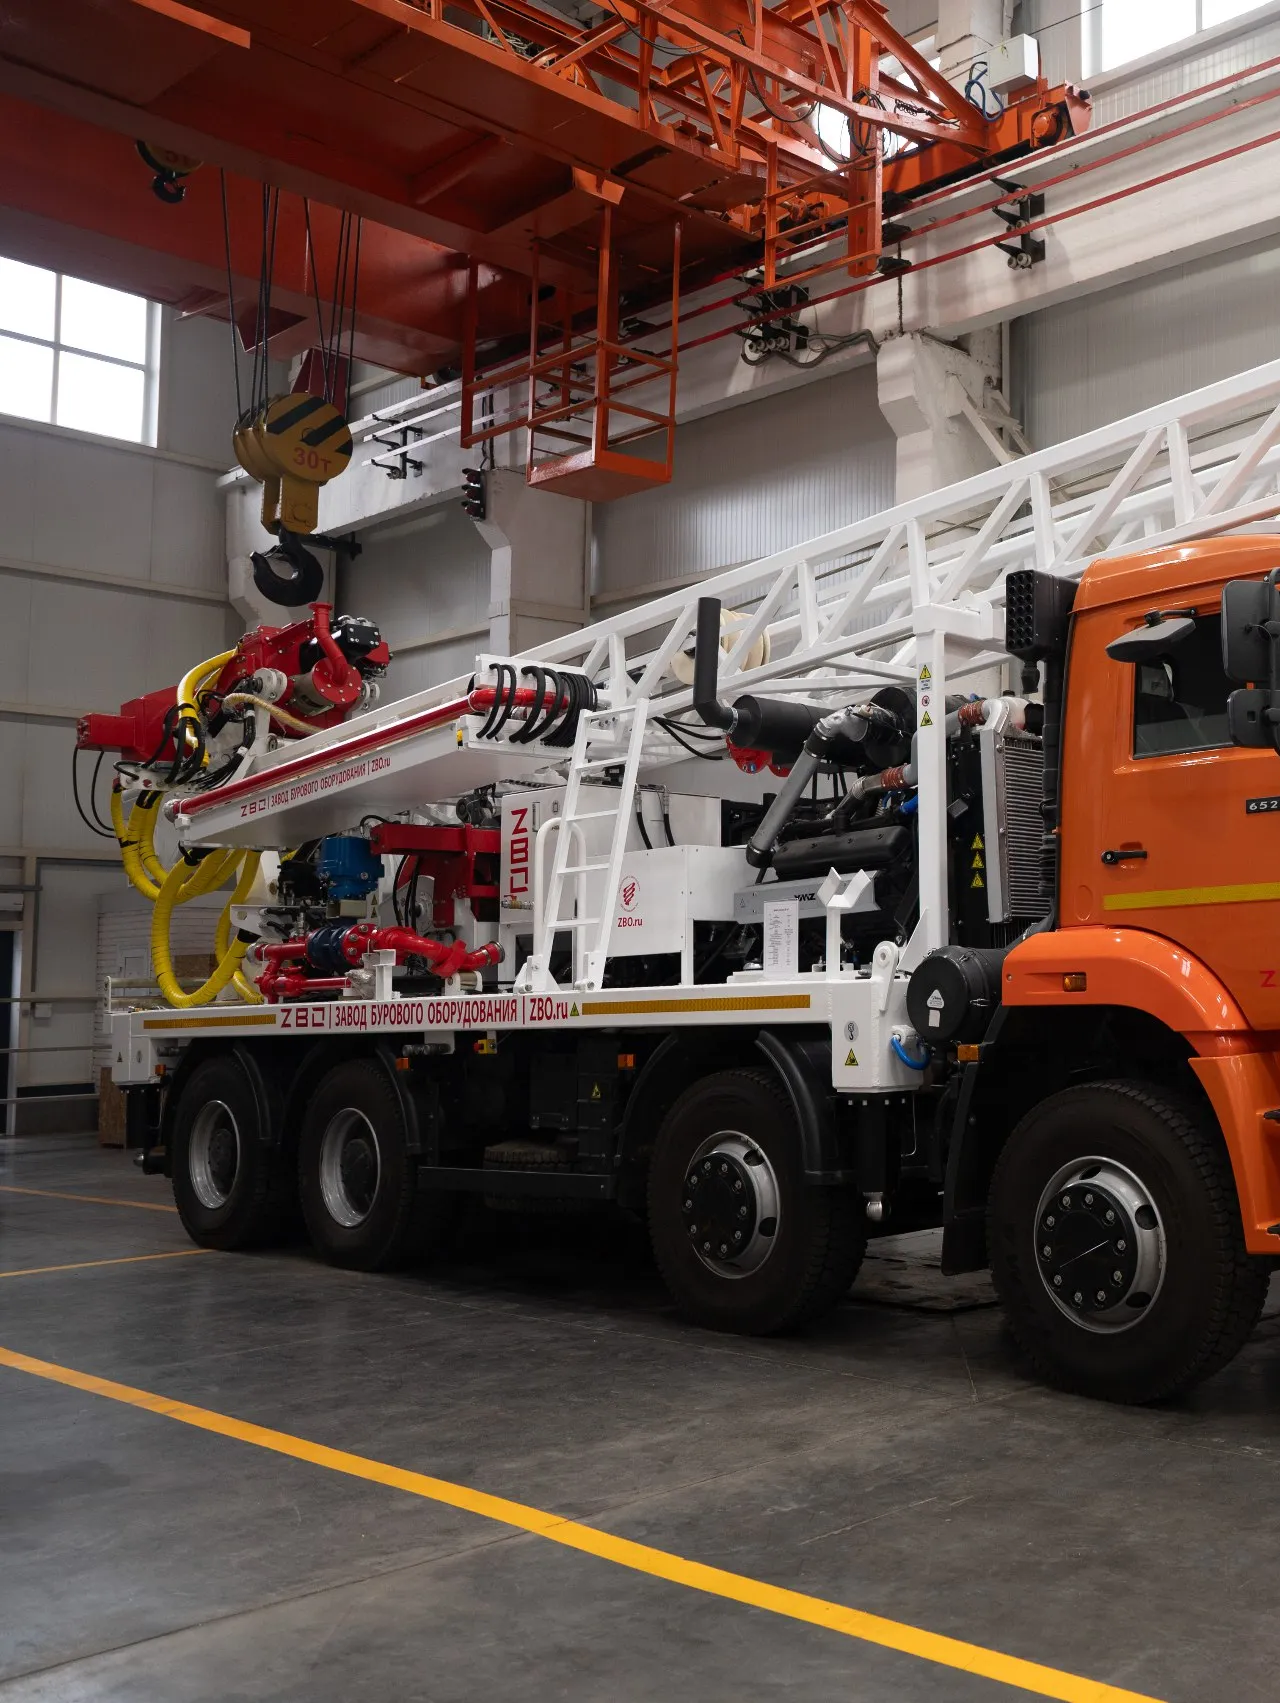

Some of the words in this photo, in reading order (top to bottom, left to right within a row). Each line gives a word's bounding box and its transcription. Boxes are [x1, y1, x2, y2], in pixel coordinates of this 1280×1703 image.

[271, 790, 289, 807] ЗАВОД
[290, 780, 319, 800] БУРОВОГО
[320, 762, 366, 790] ОБОРУДОВАНИЯ
[371, 757, 391, 772] ZBO.ru
[617, 916, 643, 928] ZBO.ru
[280, 1006, 325, 1028] ZBO
[335, 1004, 367, 1031] ЗАВОД
[370, 1002, 424, 1026] БУРОВОГО
[427, 999, 517, 1028] ОБОРУДОВАНИЯ
[529, 997, 568, 1021] ZBO.ru
